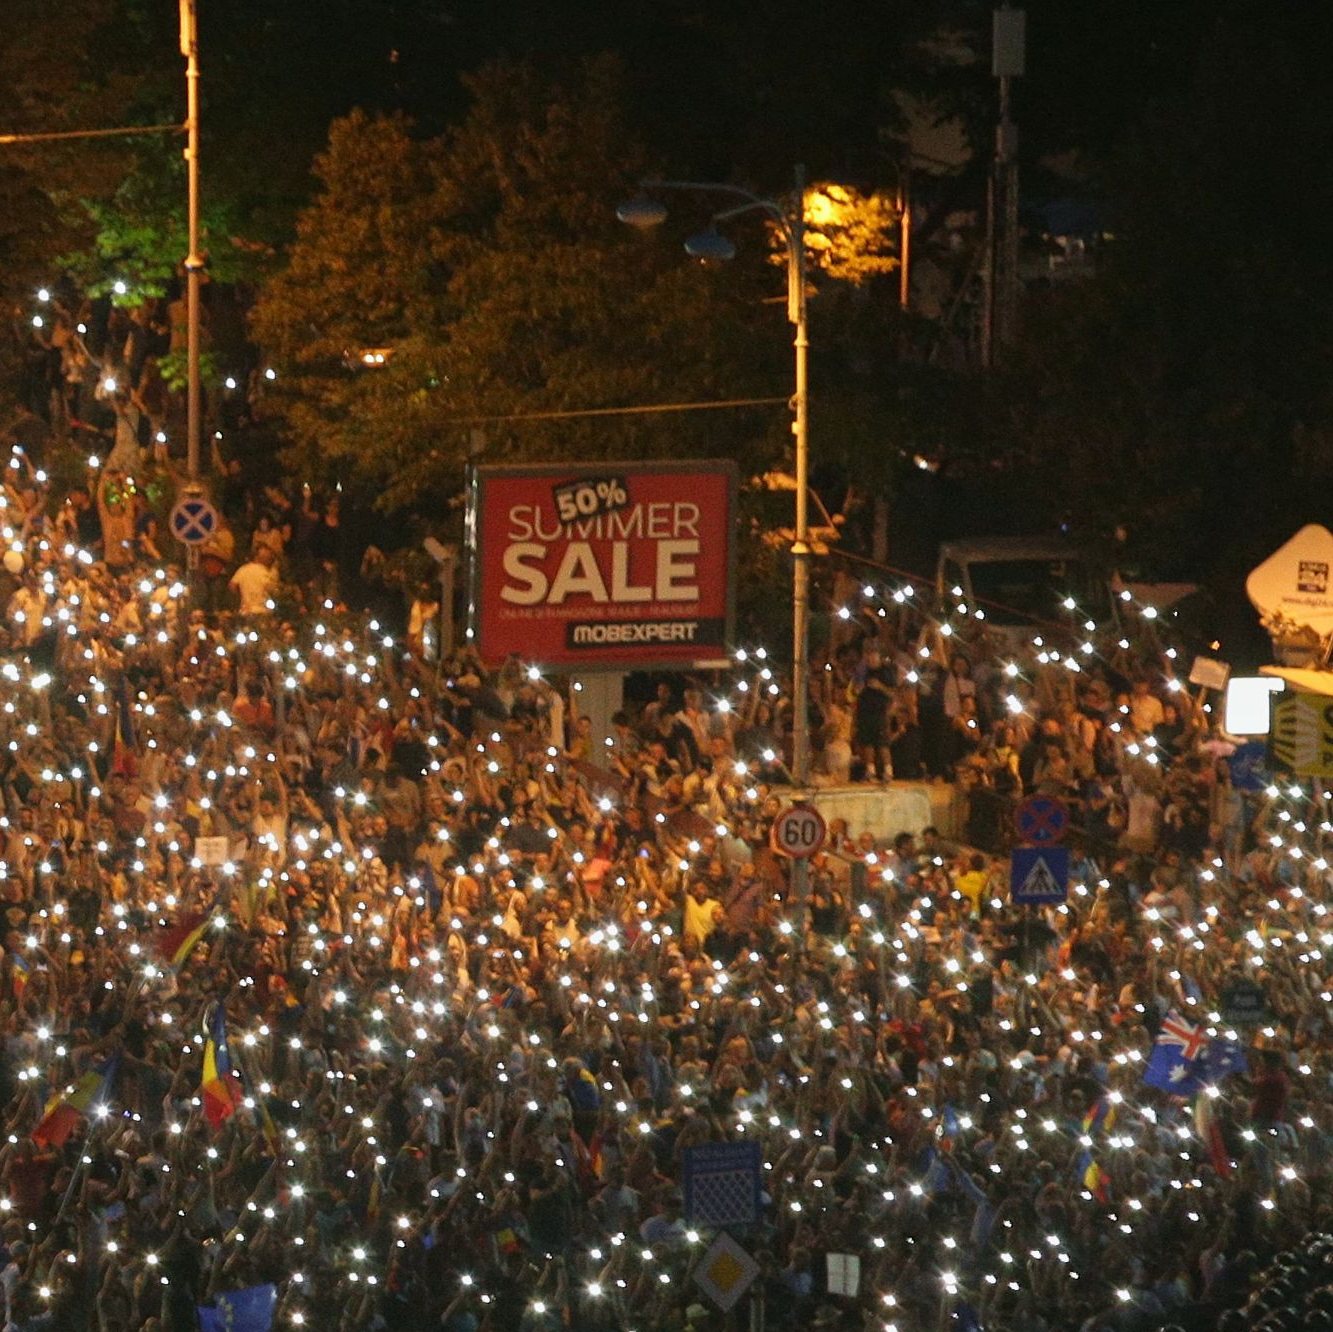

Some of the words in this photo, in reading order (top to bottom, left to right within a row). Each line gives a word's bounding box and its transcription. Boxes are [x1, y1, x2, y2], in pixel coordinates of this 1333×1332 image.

[556, 478, 628, 522] 50%
[507, 502, 700, 542] SUMMER
[499, 539, 701, 606] SALE
[572, 620, 699, 645] MOBEXPERT
[785, 819, 816, 846] 60
